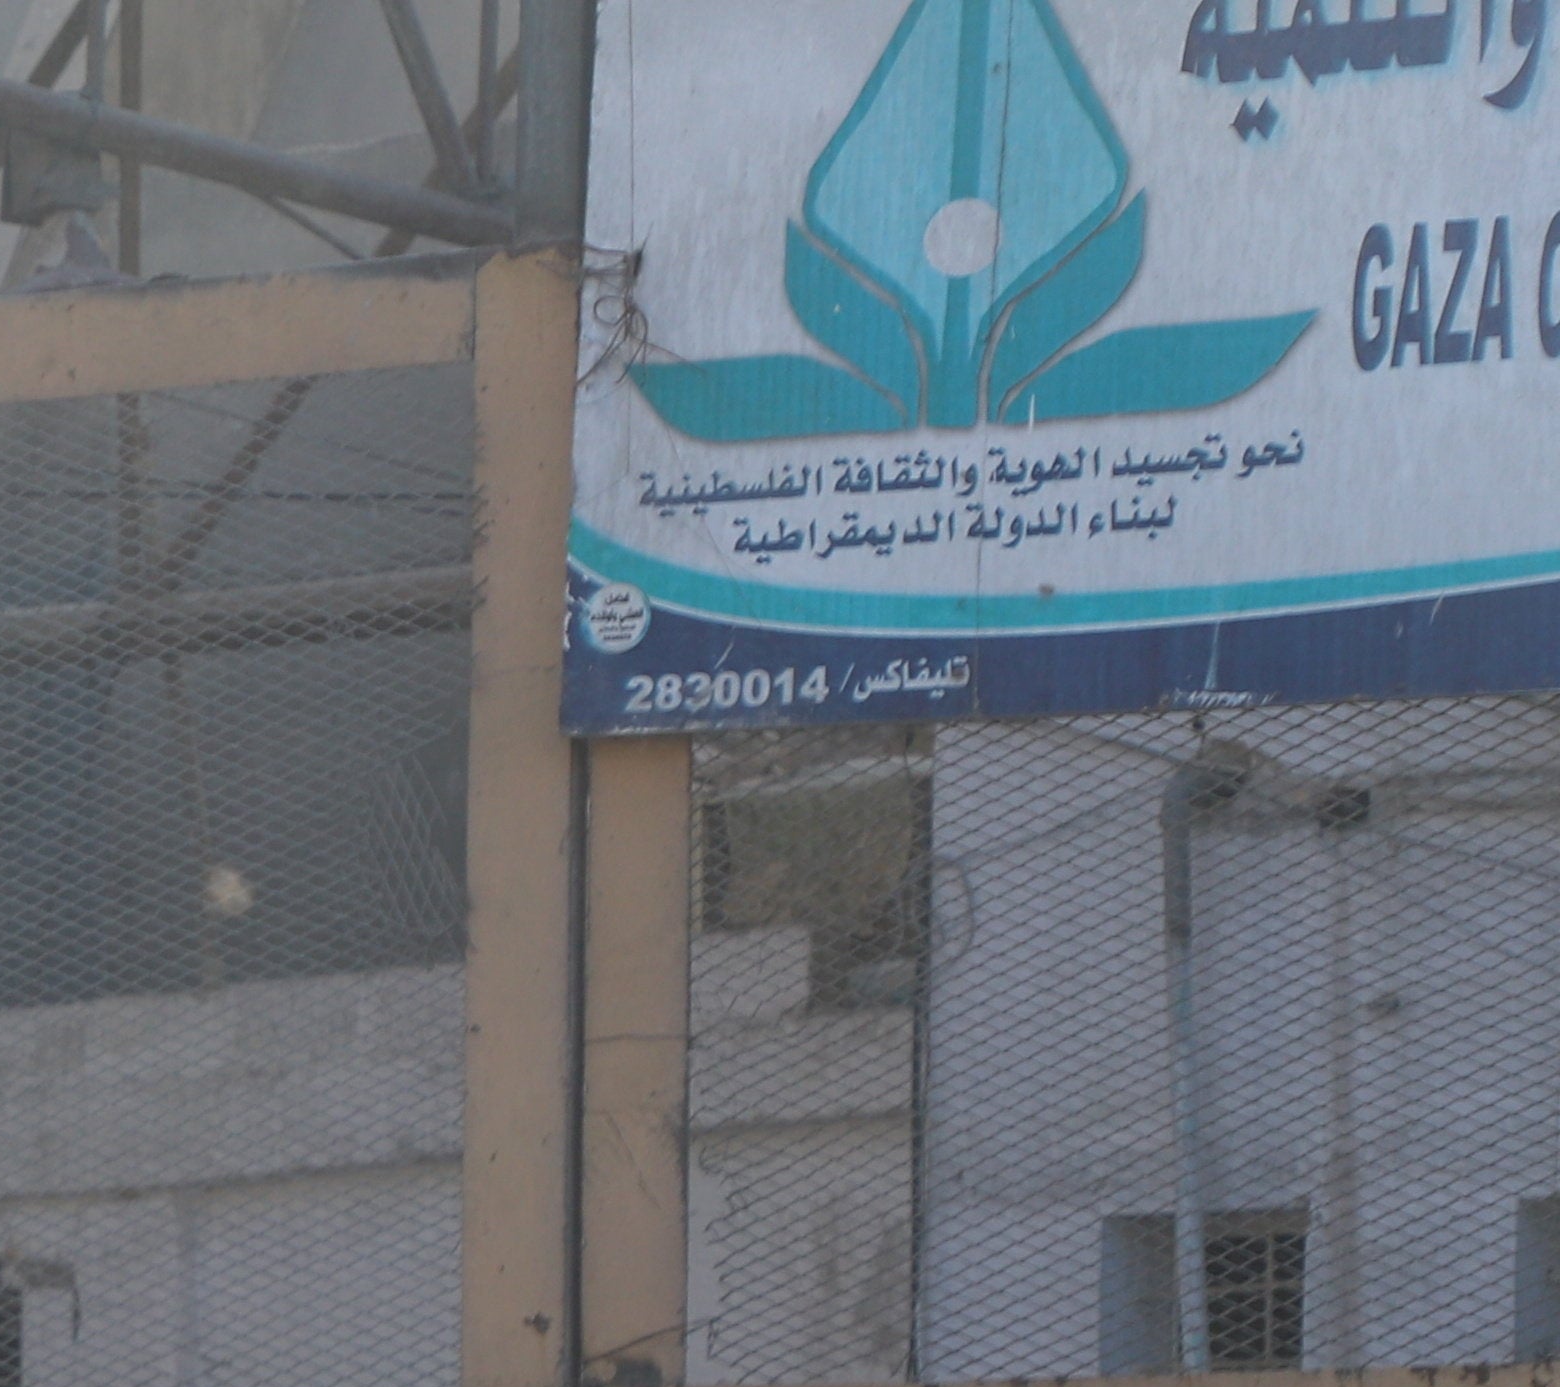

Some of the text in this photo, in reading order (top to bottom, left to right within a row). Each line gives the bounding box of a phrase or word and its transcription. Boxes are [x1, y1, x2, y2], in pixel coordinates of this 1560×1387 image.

[1352, 214, 1514, 372] GAZA
[639, 428, 1306, 517] نحو تجسيد الهوية والثقافة الفلسطينية
[733, 494, 1178, 563] لبناء الدولة الديمقراطية
[623, 664, 831, 714] 2830014
